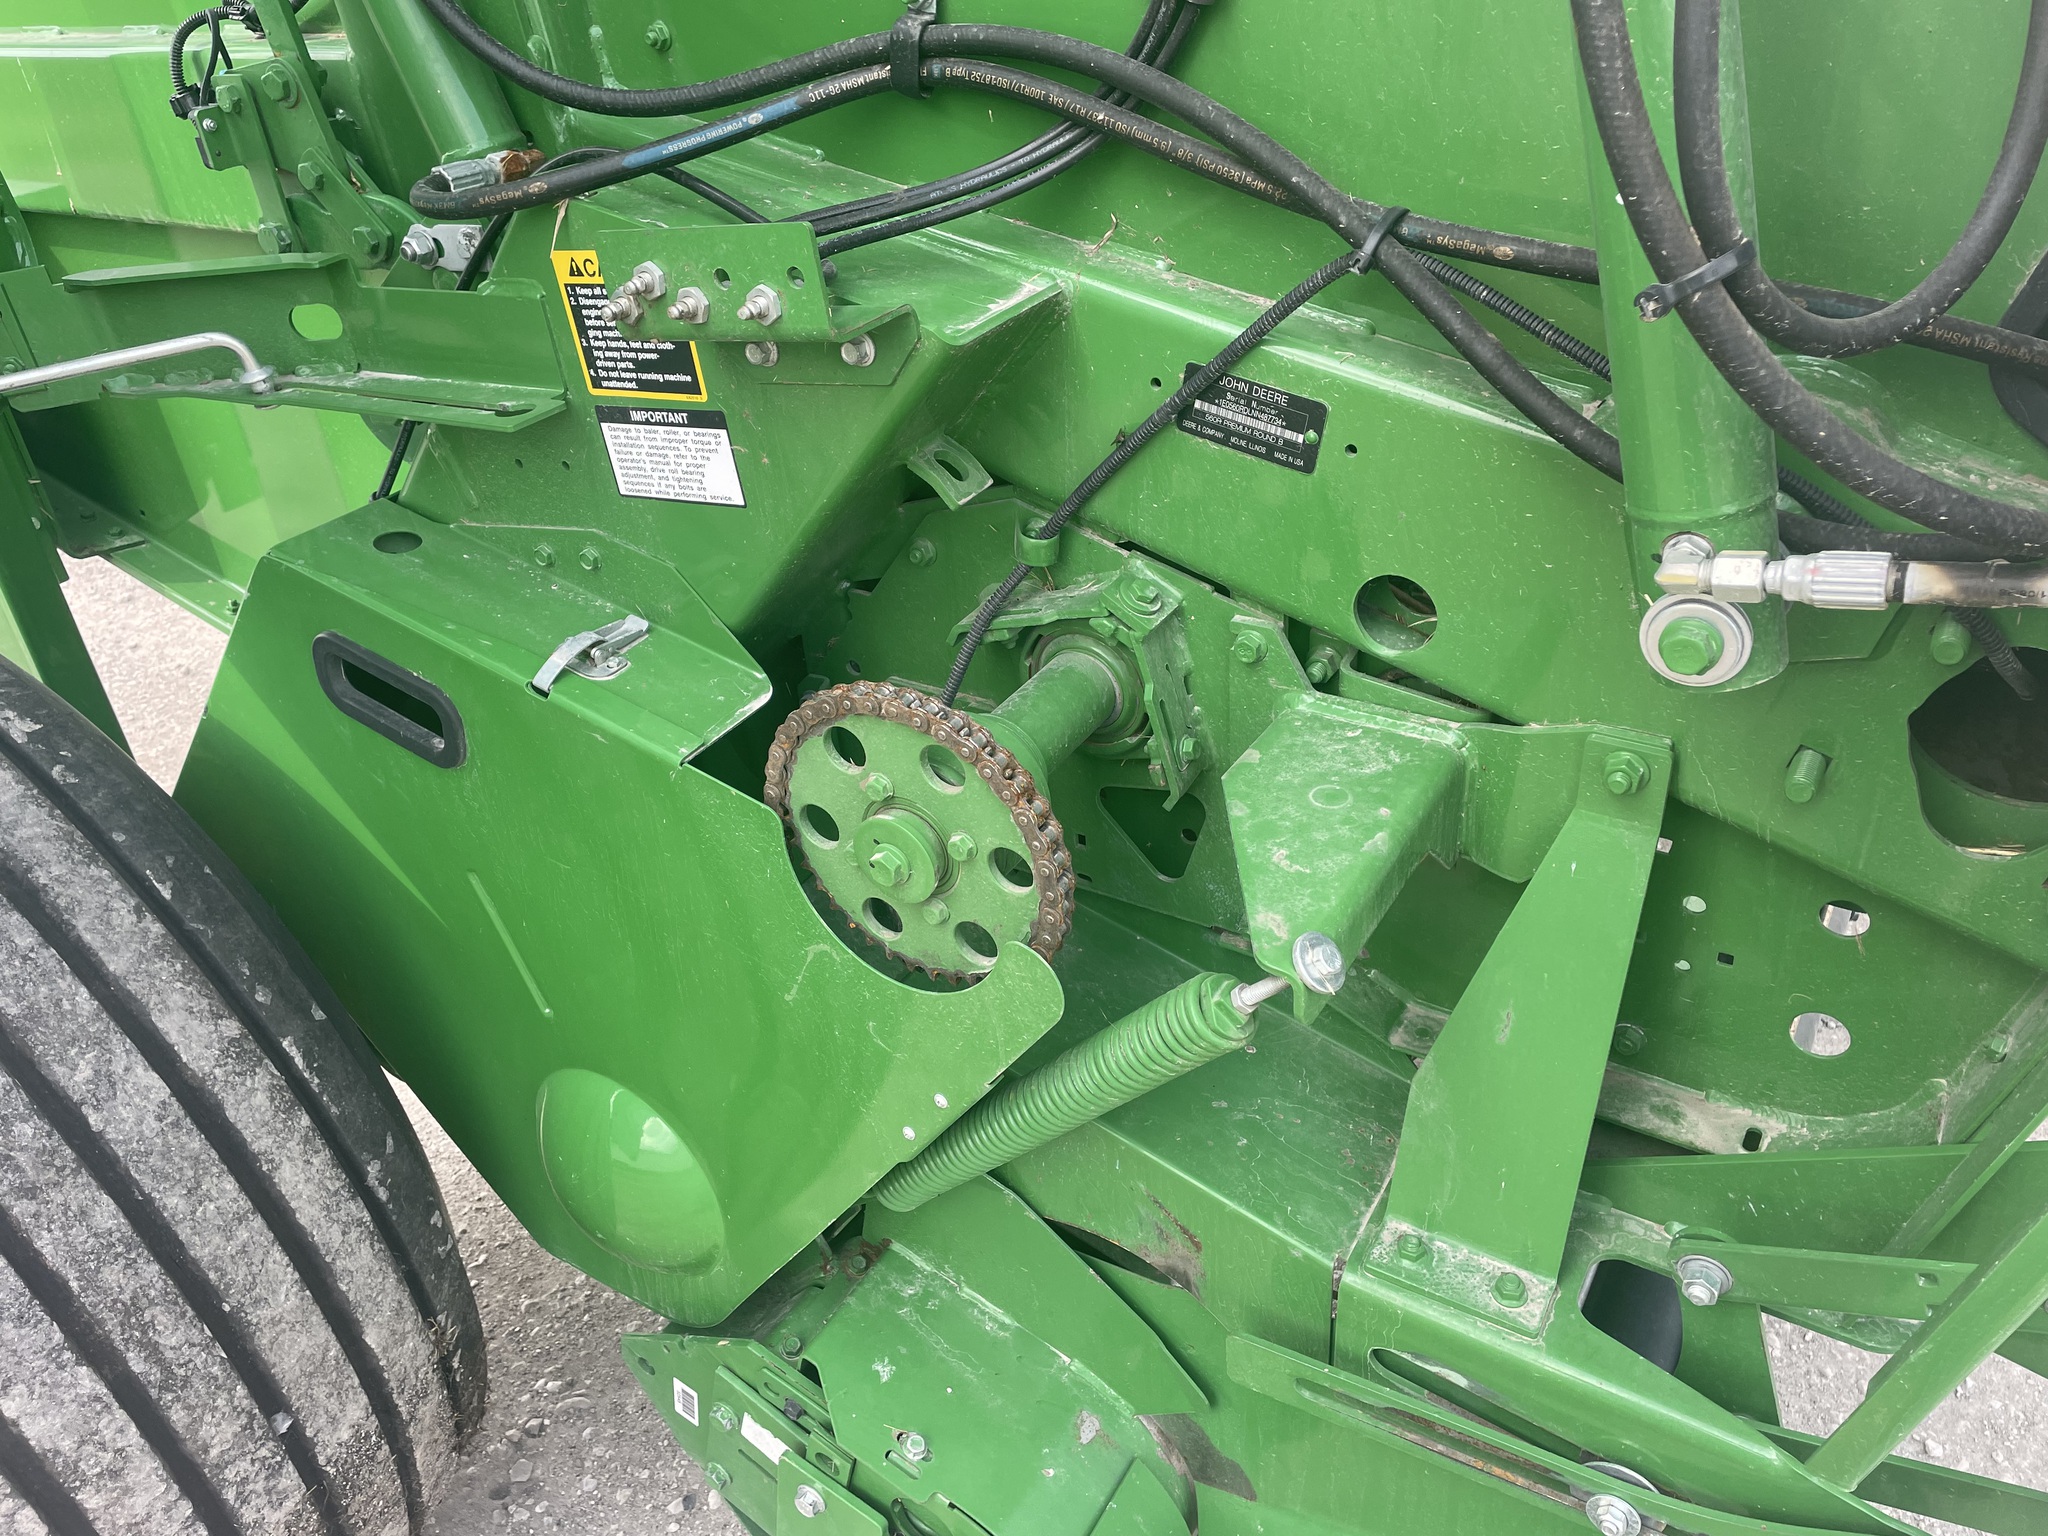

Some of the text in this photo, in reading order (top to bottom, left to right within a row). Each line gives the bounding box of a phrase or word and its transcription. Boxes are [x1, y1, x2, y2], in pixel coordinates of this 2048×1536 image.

[946, 68, 951, 77] B
[951, 67, 969, 80] Type
[841, 76, 865, 93] MSHA
[809, 84, 841, 102] 2G-11C
[1048, 94, 1064, 107] SAE
[706, 120, 743, 140] POWERING
[1019, 154, 1030, 164] TO
[1246, 177, 1266, 192] MPa
[576, 287, 592, 296] Keep
[593, 287, 601, 295] all
[588, 330, 602, 338] ging
[1935, 328, 1972, 347] MSHA
[590, 339, 606, 349] Keep
[607, 341, 629, 349] hands,
[643, 341, 655, 349] and
[657, 341, 675, 350] cloth-
[1974, 339, 2032, 363] Resistant
[593, 349, 659, 360] ing away from power-
[596, 359, 635, 369] driven parts.
[620, 370, 637, 379] leave
[638, 372, 663, 382] running
[664, 373, 692, 382] machine
[1219, 376, 1289, 406] JOHN DEERE
[1226, 392, 1278, 415] Serial Number
[630, 411, 688, 424] IMPORTANT
[608, 426, 632, 435] Damage
[644, 428, 660, 436] baler,
[663, 429, 681, 437] roller,
[693, 431, 721, 439] bearings
[1205, 414, 1284, 445] 560R PREMIUM ROUND B
[612, 441, 645, 449] installation
[648, 444, 682, 452] sequences.
[695, 447, 718, 455] prevent
[661, 437, 688, 445] improper
[691, 438, 712, 447] torque
[1183, 420, 1197, 430] DEERE
[1274, 451, 1287, 462] MADE
[1288, 455, 1293, 463] IN
[1294, 458, 1303, 467] USA
[617, 457, 646, 465] operator's
[645, 451, 671, 459] damage,
[619, 465, 648, 473] assembly,
[682, 468, 704, 478] bearing
[621, 472, 655, 481] adjustment,
[672, 475, 703, 485] tightening
[623, 480, 654, 488] sequences
[679, 483, 694, 491] bolts
[625, 487, 651, 495] loosened
[674, 491, 707, 500] performing
